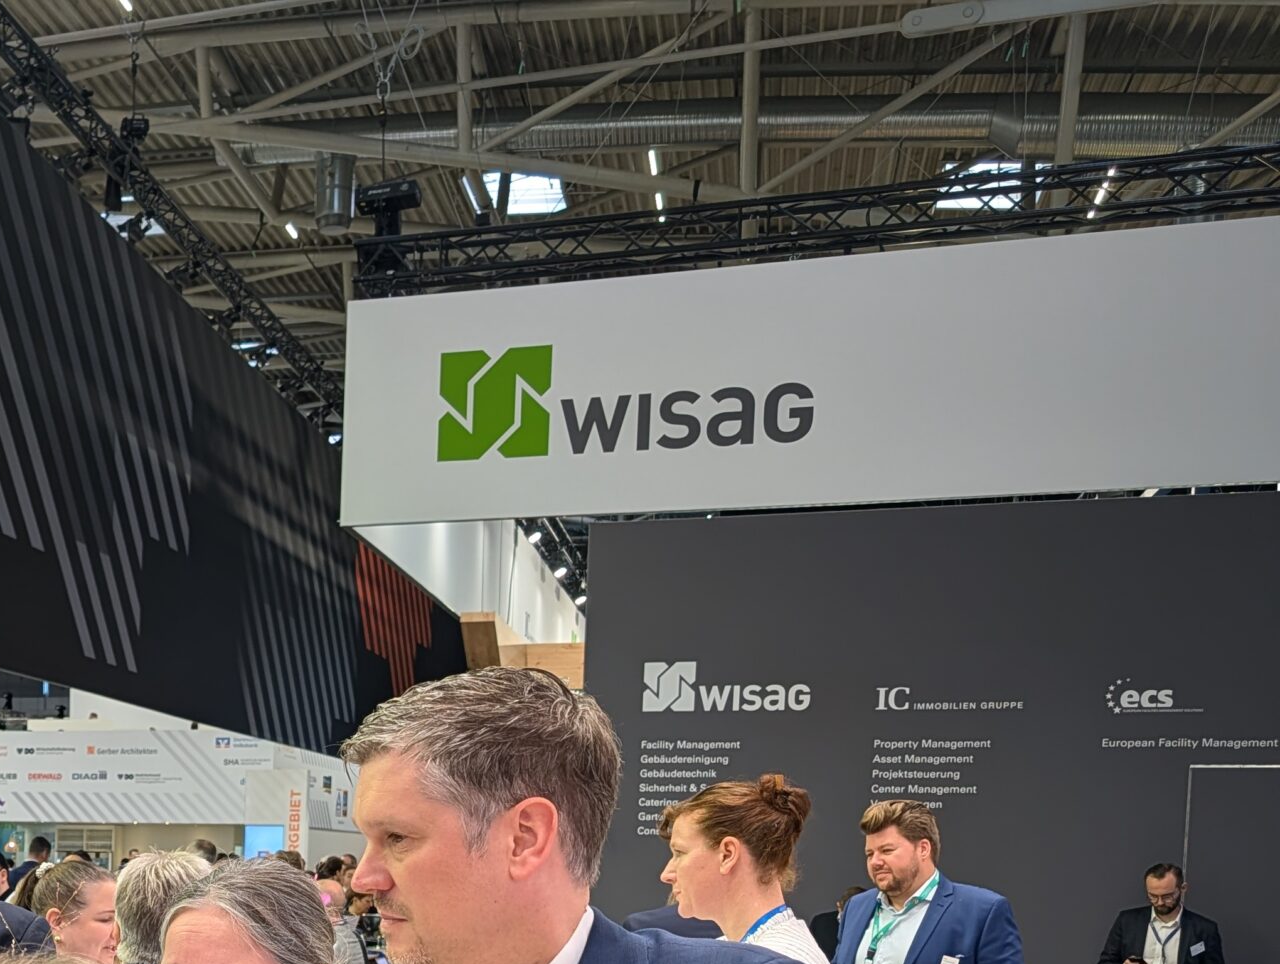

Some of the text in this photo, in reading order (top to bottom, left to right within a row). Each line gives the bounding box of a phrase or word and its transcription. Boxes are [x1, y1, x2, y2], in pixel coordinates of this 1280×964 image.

[875, 686, 1024, 711] IC IMMOBILIEN GRUPPE
[1120, 689, 1174, 708] ecs
[640, 740, 741, 751] Facility Management
[873, 739, 991, 750] Property Management
[1101, 738, 1279, 750] European Facility Management
[640, 754, 729, 765] Gebäudereinigung
[872, 754, 974, 765] Asset Management
[639, 769, 717, 779] Gebäudetechnik
[872, 769, 960, 780] Projektsteuerung
[639, 783, 687, 793] Sicherheit
[689, 783, 698, 793] &
[871, 784, 977, 795] Center Management
